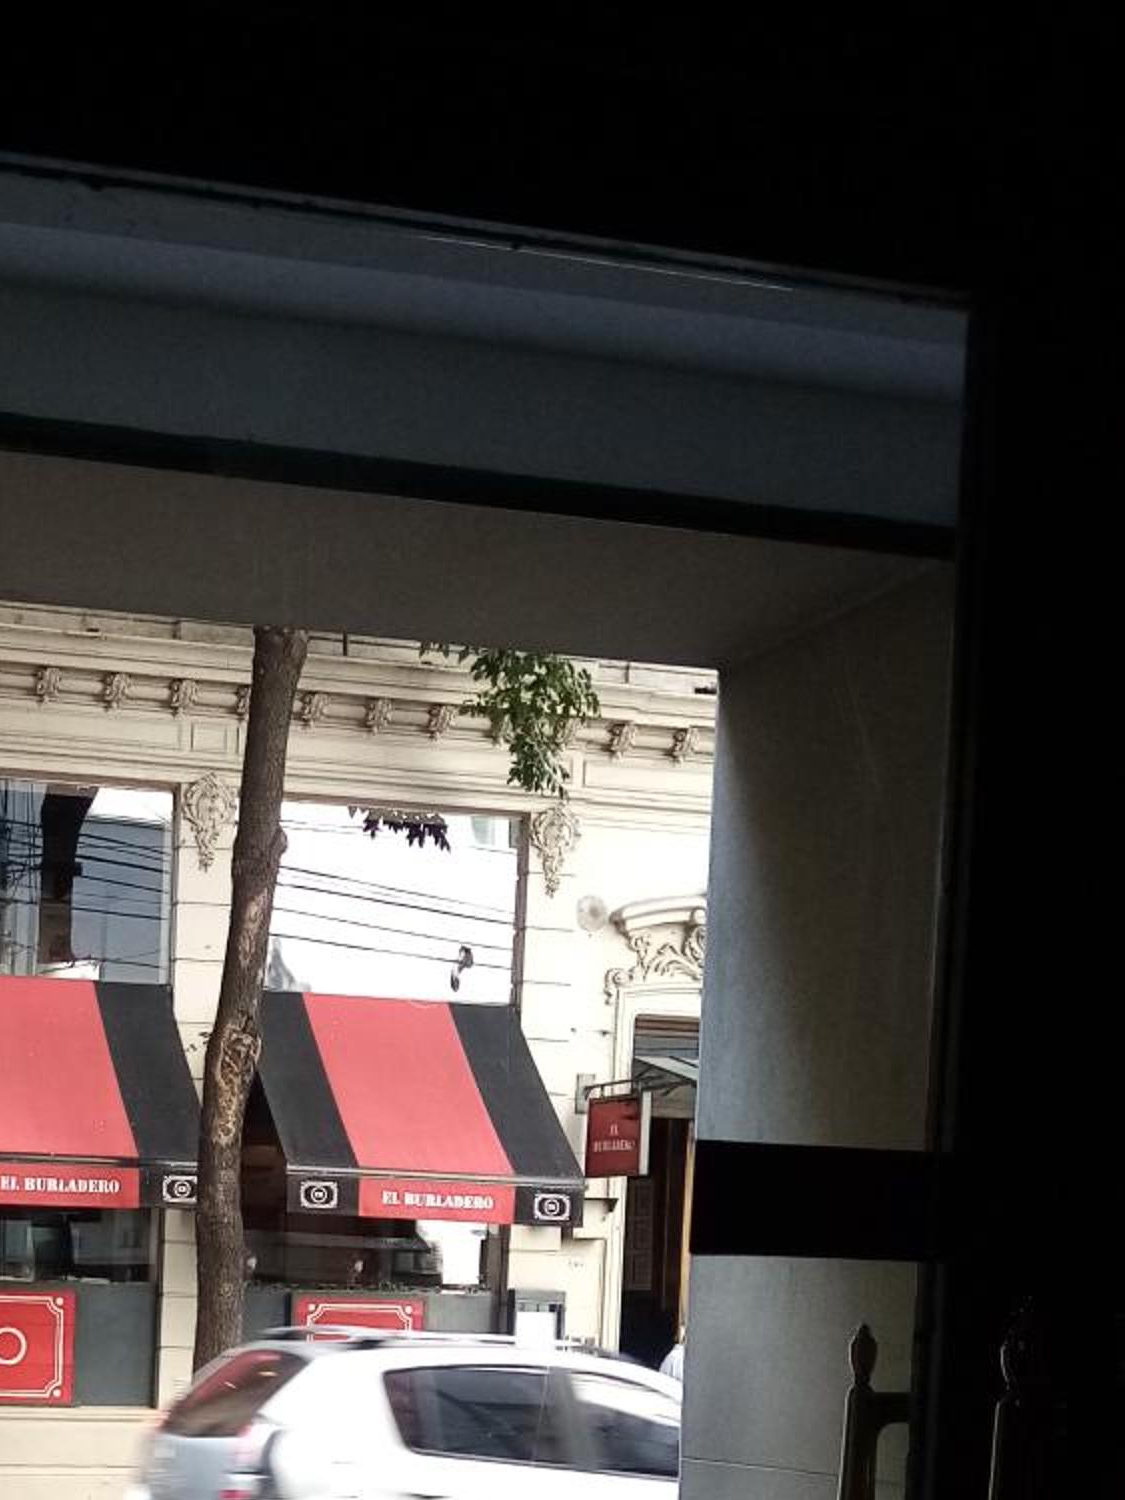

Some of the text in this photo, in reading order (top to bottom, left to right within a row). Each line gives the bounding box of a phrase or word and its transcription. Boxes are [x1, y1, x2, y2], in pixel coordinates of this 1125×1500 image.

[0, 1175, 120, 1193] EL BURLADERO
[382, 1190, 493, 1209] EL BURLADERO
